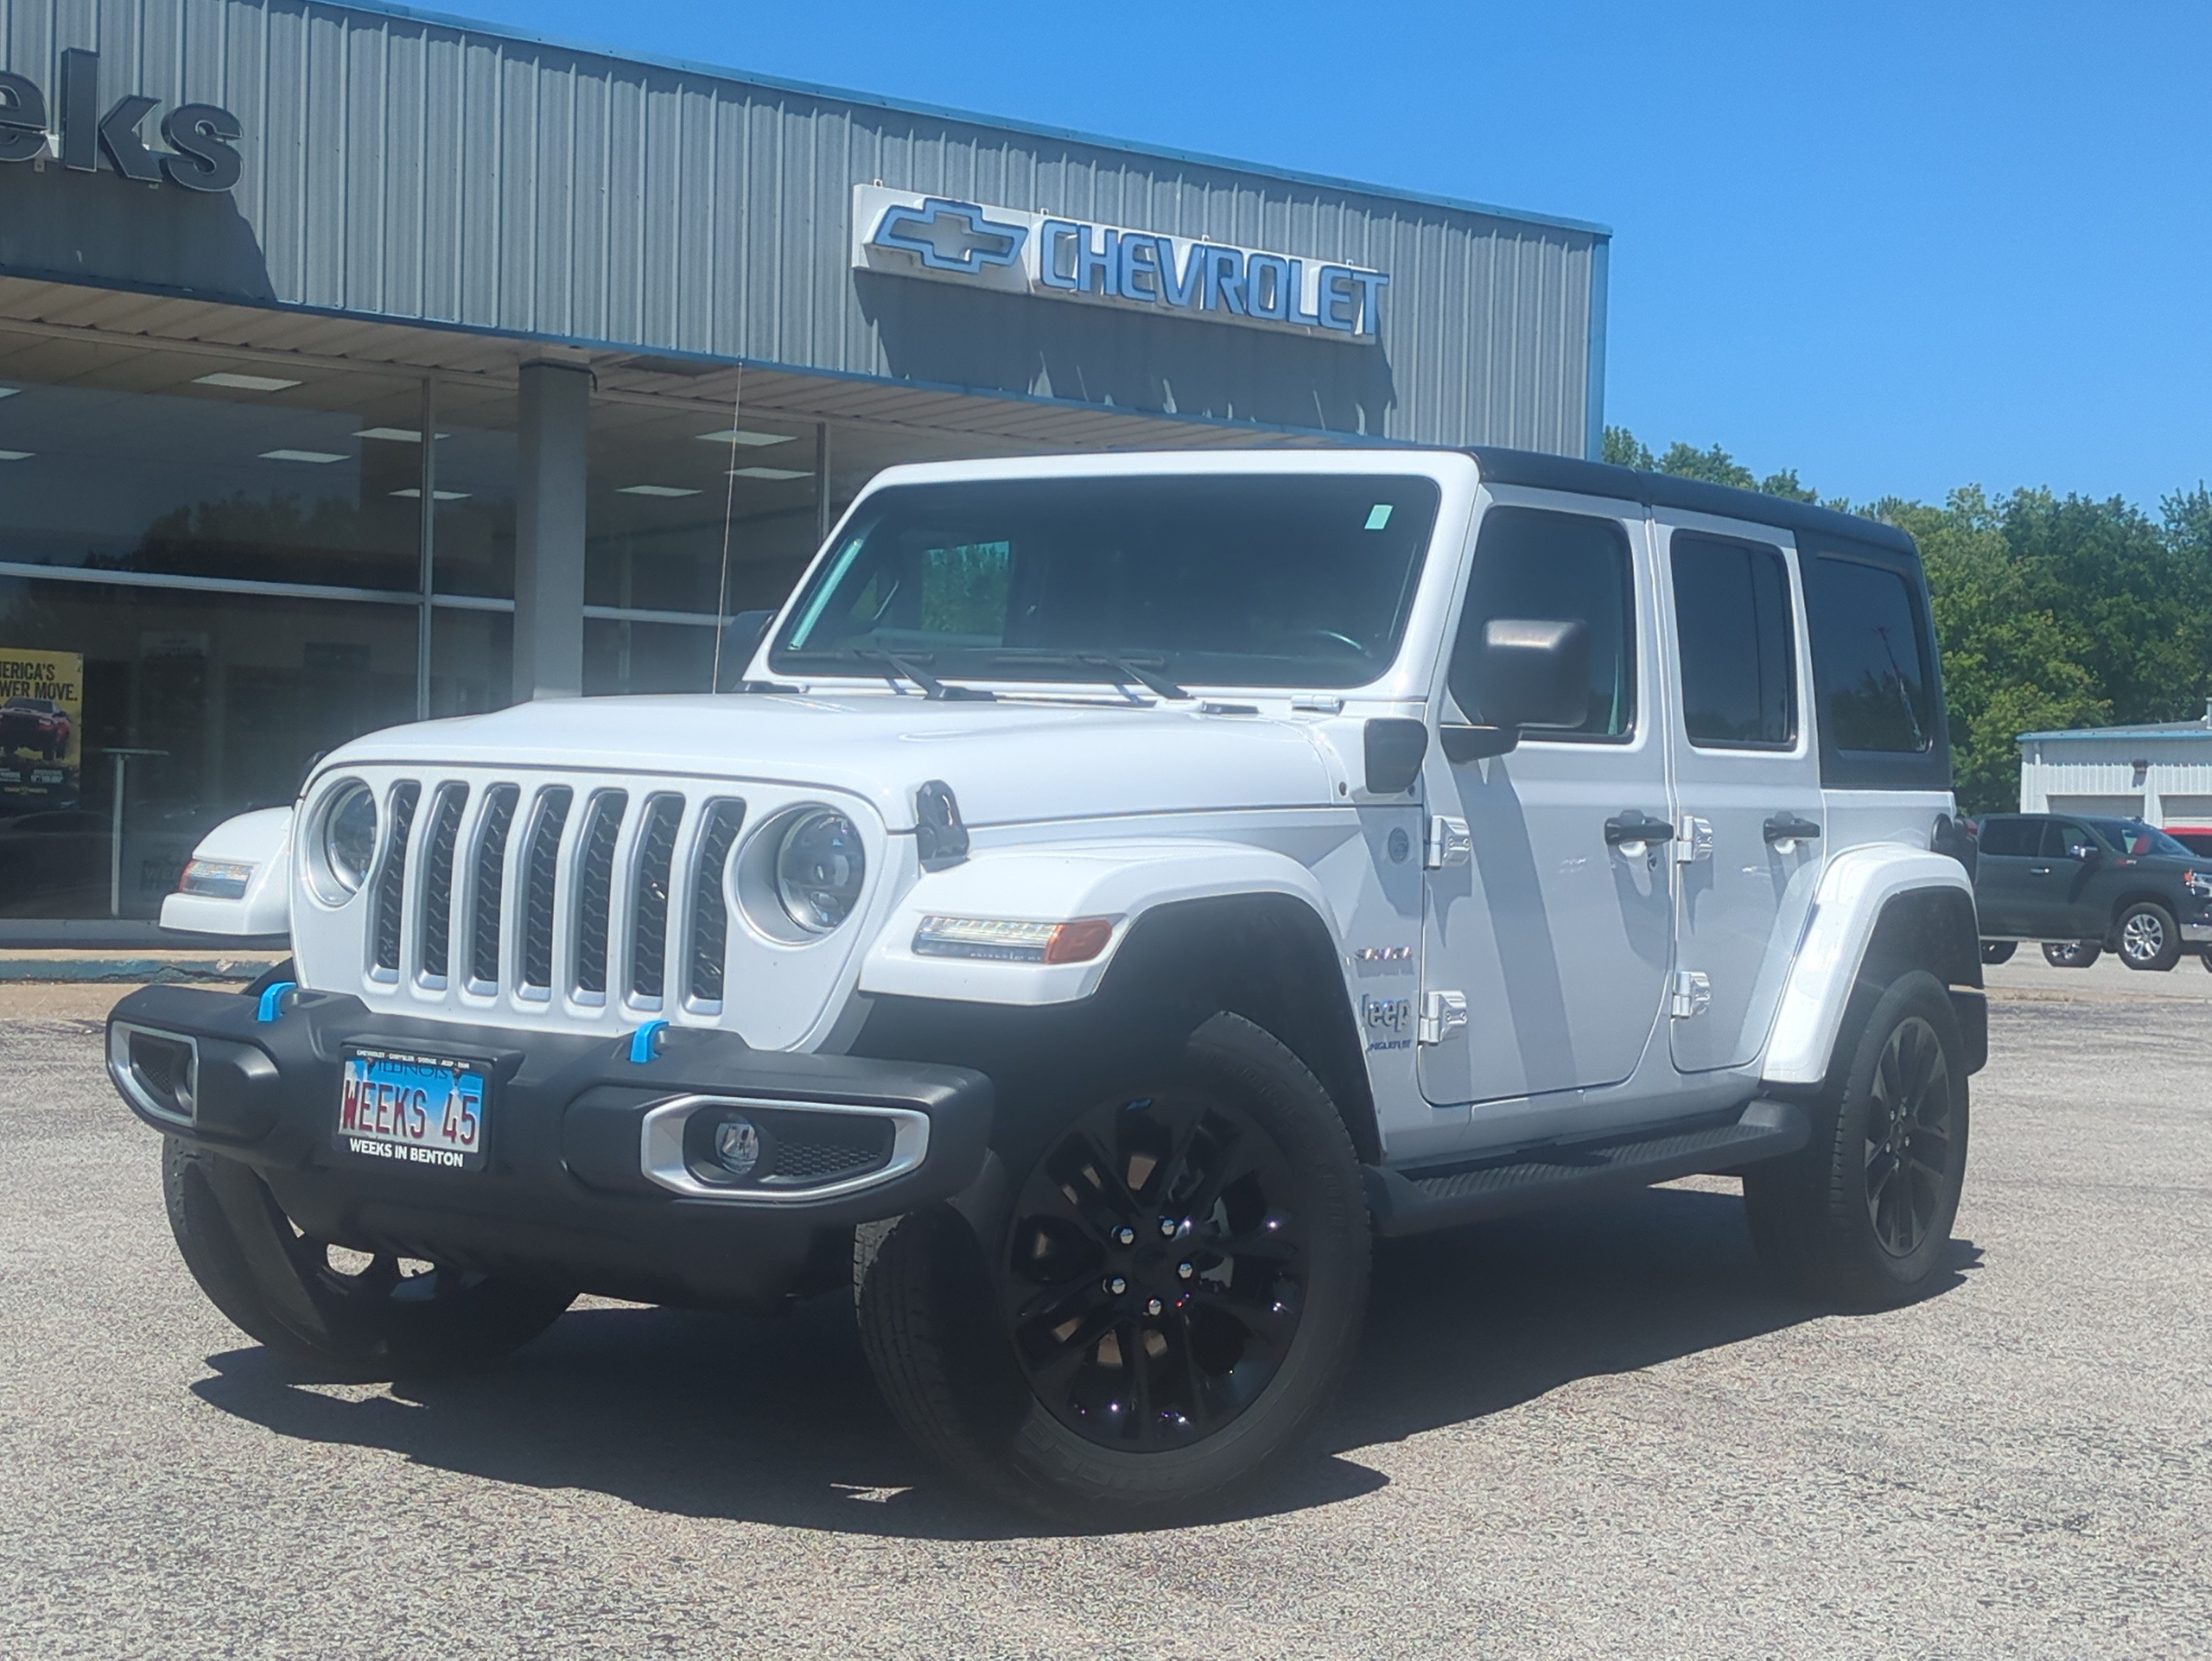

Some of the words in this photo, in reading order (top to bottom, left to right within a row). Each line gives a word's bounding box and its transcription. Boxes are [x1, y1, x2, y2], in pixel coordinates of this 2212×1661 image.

[1040, 218, 1390, 335] CHEVROLET
[0, 661, 55, 681] ERICA'S
[35, 681, 78, 701] MOVE.
[1361, 993, 1411, 1032] Jeep
[343, 1079, 427, 1139] WEEKS
[442, 1093, 478, 1145] 45
[350, 1138, 392, 1159] WEEKS
[395, 1145, 408, 1160] IN
[410, 1147, 463, 1167] BENTON
